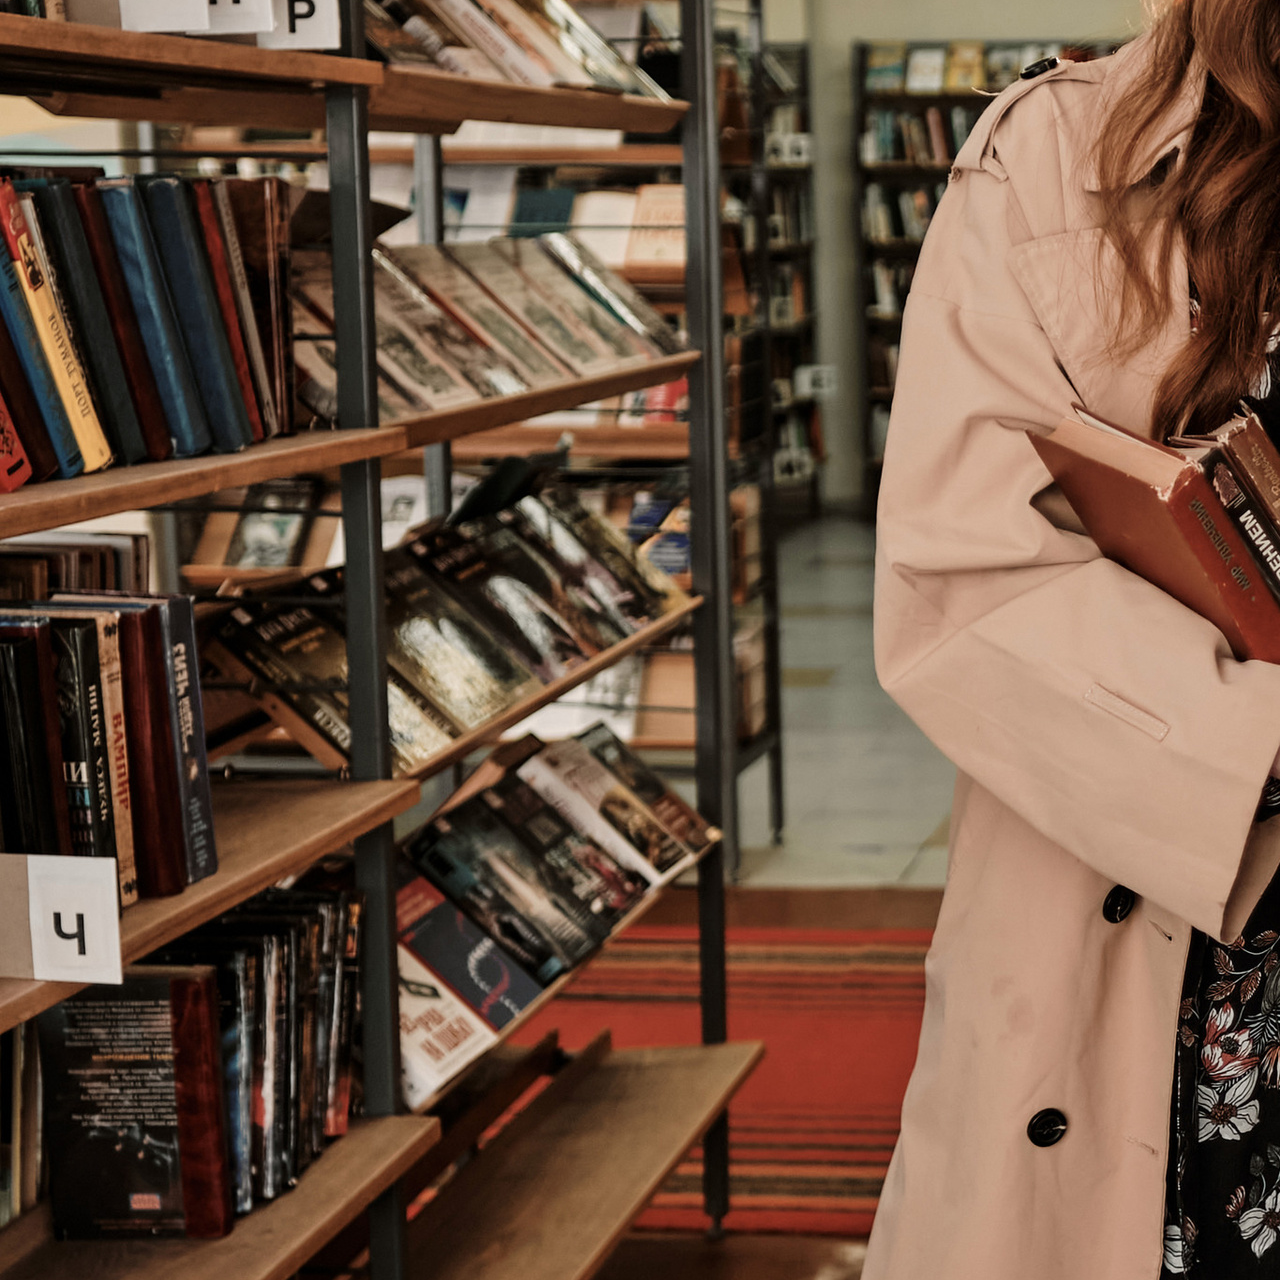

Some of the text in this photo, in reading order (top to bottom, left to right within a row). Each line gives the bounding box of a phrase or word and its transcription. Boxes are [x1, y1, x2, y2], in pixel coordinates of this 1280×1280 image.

[1187, 498, 1251, 592] МИР УВЛЕЧЕНИЙ
[110, 712, 131, 811] ВАМПИР
[52, 911, 88, 957] Ч
